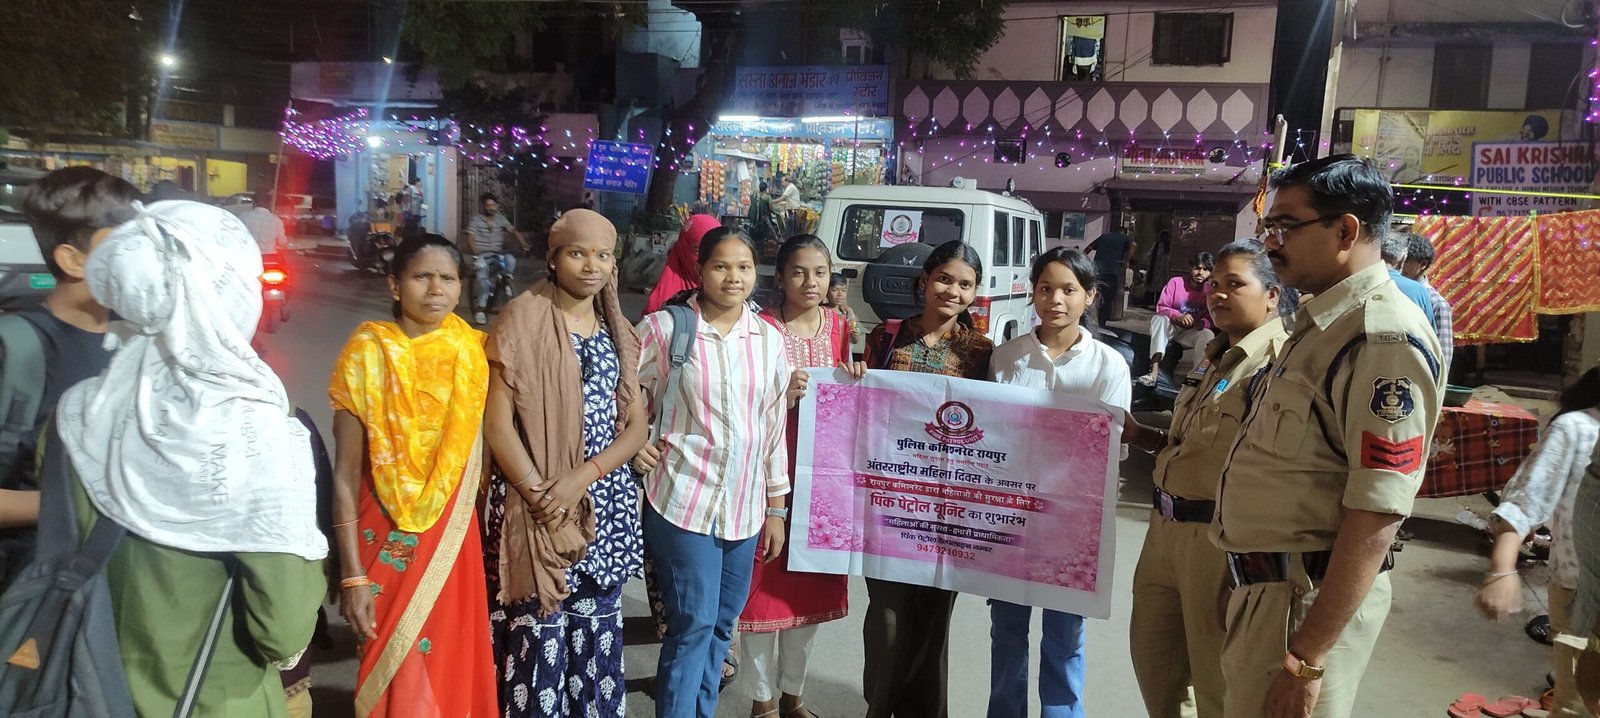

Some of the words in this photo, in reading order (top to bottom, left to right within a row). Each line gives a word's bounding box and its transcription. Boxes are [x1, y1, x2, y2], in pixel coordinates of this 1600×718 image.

[737, 72, 766, 89] सस्ता
[800, 69, 827, 88] भंडार
[853, 83, 879, 98] स्टोर
[1480, 147, 1511, 165] SAI
[1517, 146, 1595, 165] KRISHNA
[1477, 167, 1525, 184] PUBLIC
[1532, 166, 1594, 183] SCHOOL
[1479, 197, 1502, 206] WITH
[1506, 197, 1529, 206] CBSE
[1533, 197, 1577, 206] PATTERN
[929, 429, 942, 442] PINK
[942, 435, 965, 445] PATROL
[965, 434, 980, 445] UNIT
[896, 438, 925, 450] पुलिस
[928, 441, 973, 457] कमिश्नरेट
[977, 449, 1008, 463] रायपुर
[210, 443, 229, 506] MAKE
[866, 458, 917, 476] अंतरराष्ट्रीय
[920, 464, 951, 480] महिला
[954, 467, 982, 484] दिवस
[984, 475, 994, 485] के
[996, 479, 1022, 490] अवसर
[1025, 483, 1036, 491] पर
[869, 478, 891, 490] रायपुर
[892, 480, 923, 492] कमिश्नरेट
[973, 490, 982, 499] की
[984, 493, 1004, 505] सुरक्षा
[1006, 496, 1014, 505] के
[1016, 496, 1031, 508] लिए
[870, 491, 895, 508] पिंक
[899, 494, 930, 515] पेट्रोल
[933, 502, 967, 520] यूनिट
[968, 510, 982, 520] का
[984, 511, 1027, 527] शुभारंभ
[919, 521, 930, 530] की
[900, 532, 916, 540] पिंक
[917, 533, 937, 544] पेट्रोल
[916, 543, 976, 561] 9479210932
